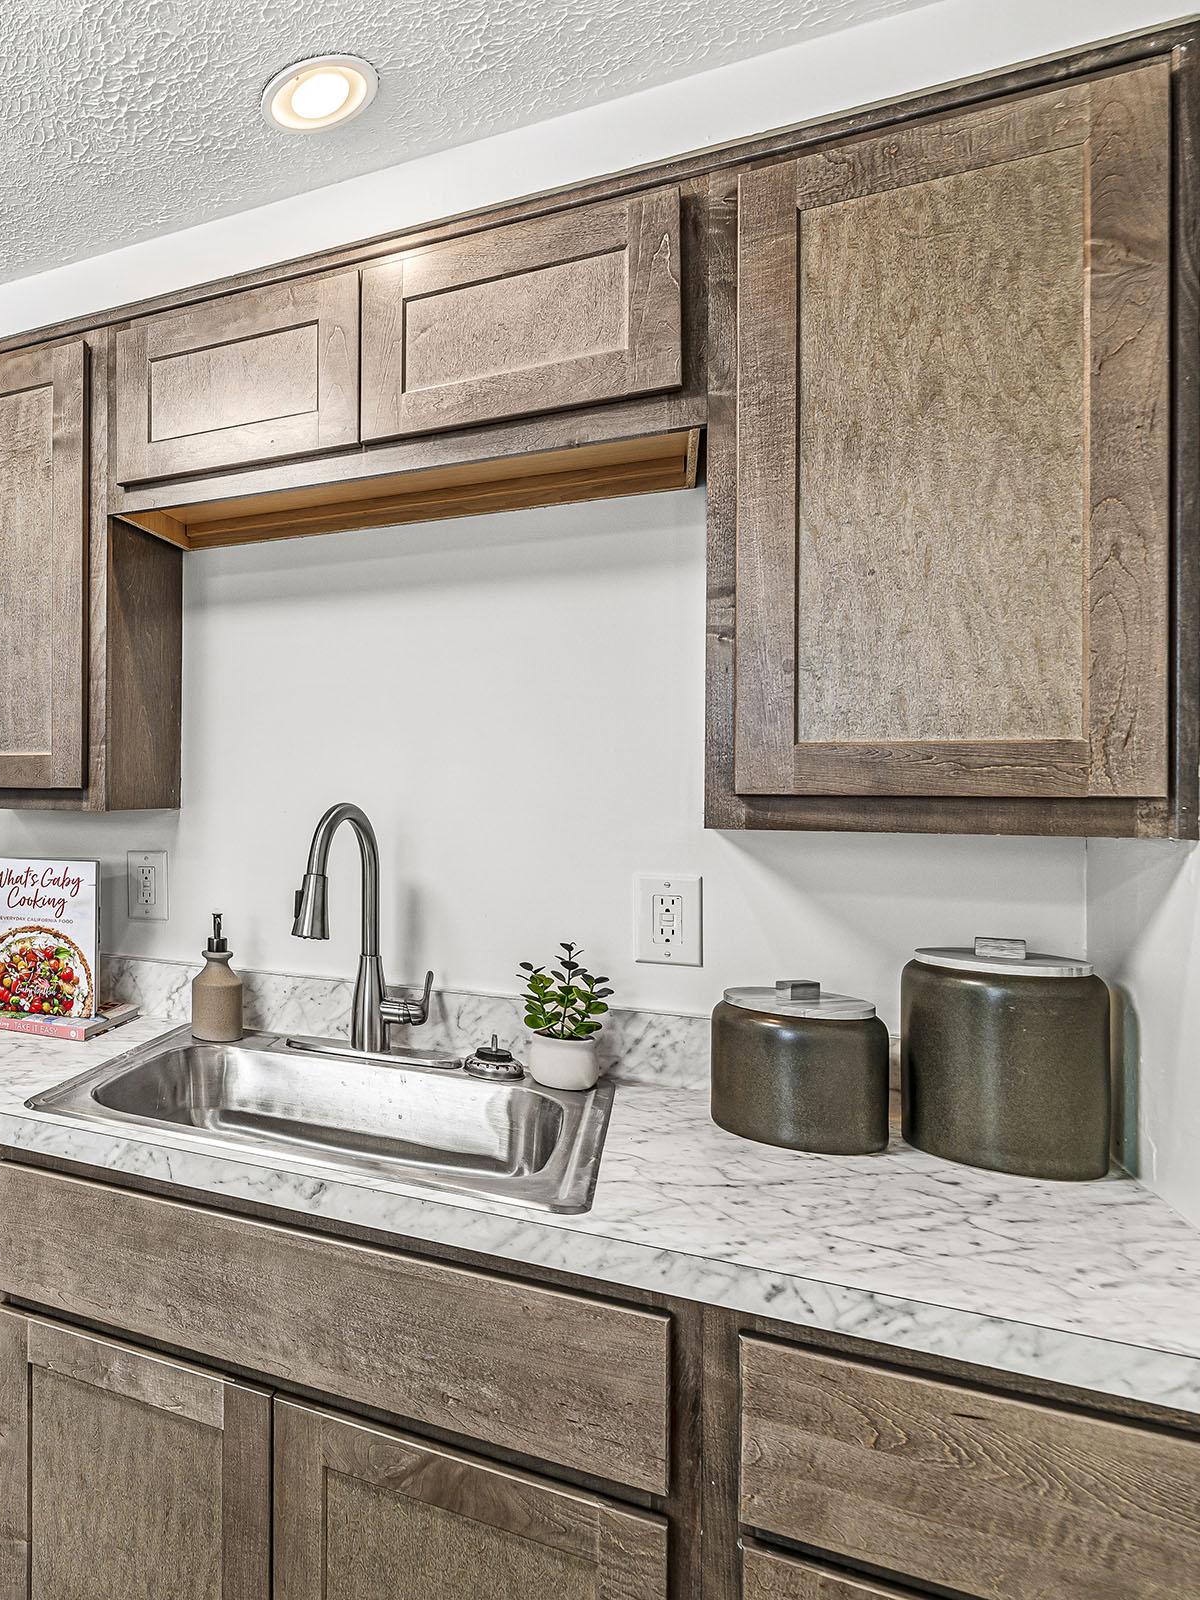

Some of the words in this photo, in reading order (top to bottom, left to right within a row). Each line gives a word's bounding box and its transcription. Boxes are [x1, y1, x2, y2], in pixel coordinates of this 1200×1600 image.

[40, 866, 84, 897] Gaby
[7, 886, 68, 918] Cooking
[14, 1021, 31, 1030] TAKE
[40, 1025, 58, 1034] EASY
